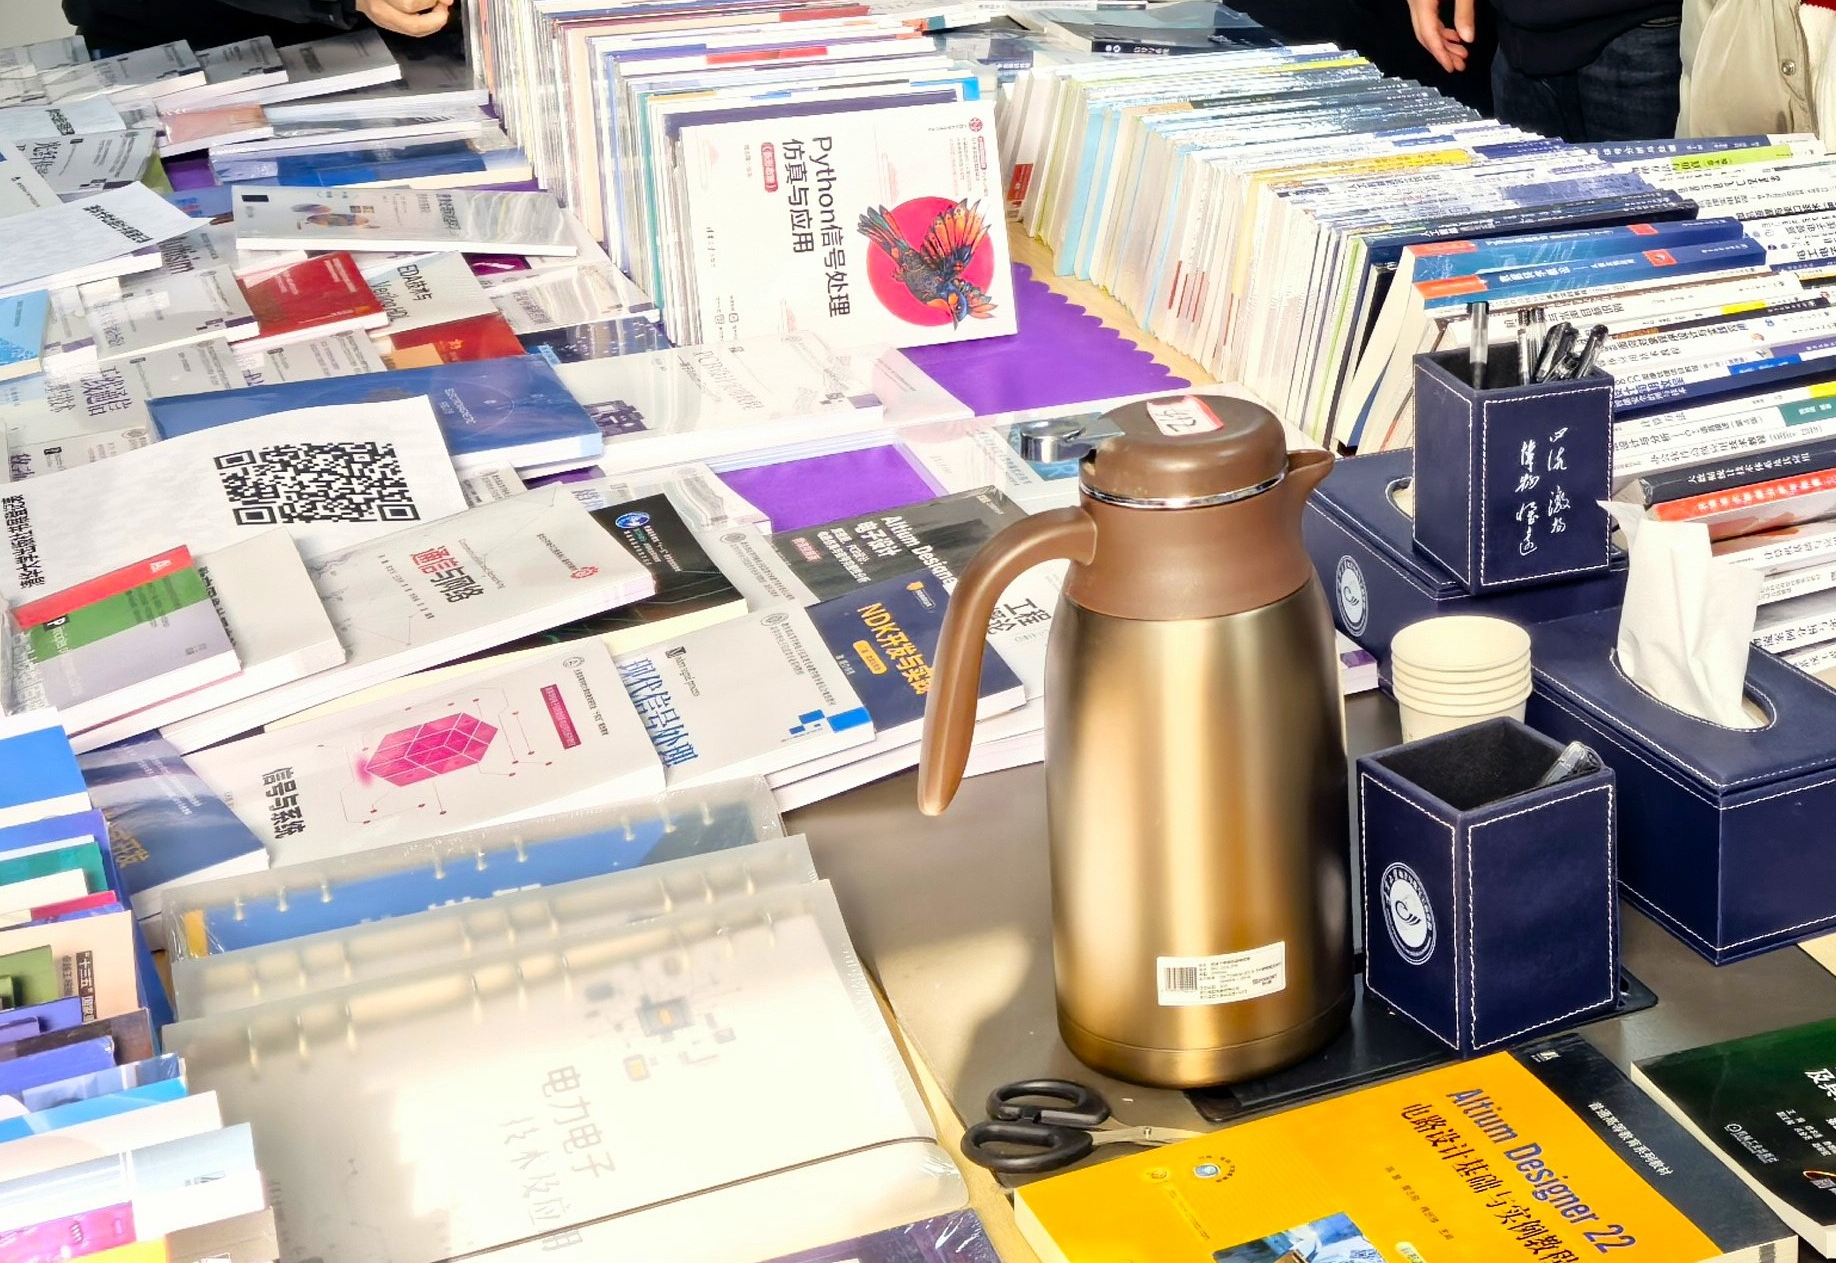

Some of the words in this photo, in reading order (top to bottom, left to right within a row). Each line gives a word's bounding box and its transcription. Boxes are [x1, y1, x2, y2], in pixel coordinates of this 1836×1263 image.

[781, 139, 816, 255] 仿真与应用
[812, 136, 852, 318] Python信号处理
[410, 544, 486, 604] 通信与网络
[881, 515, 918, 554] Altium
[904, 541, 957, 588] Designe
[262, 765, 306, 840] 信号与系统
[541, 1064, 616, 1181] 电力电子
[1444, 1087, 1518, 1146] Altium
[1504, 1141, 1601, 1226] Designer
[1583, 1222, 1637, 1256] 22
